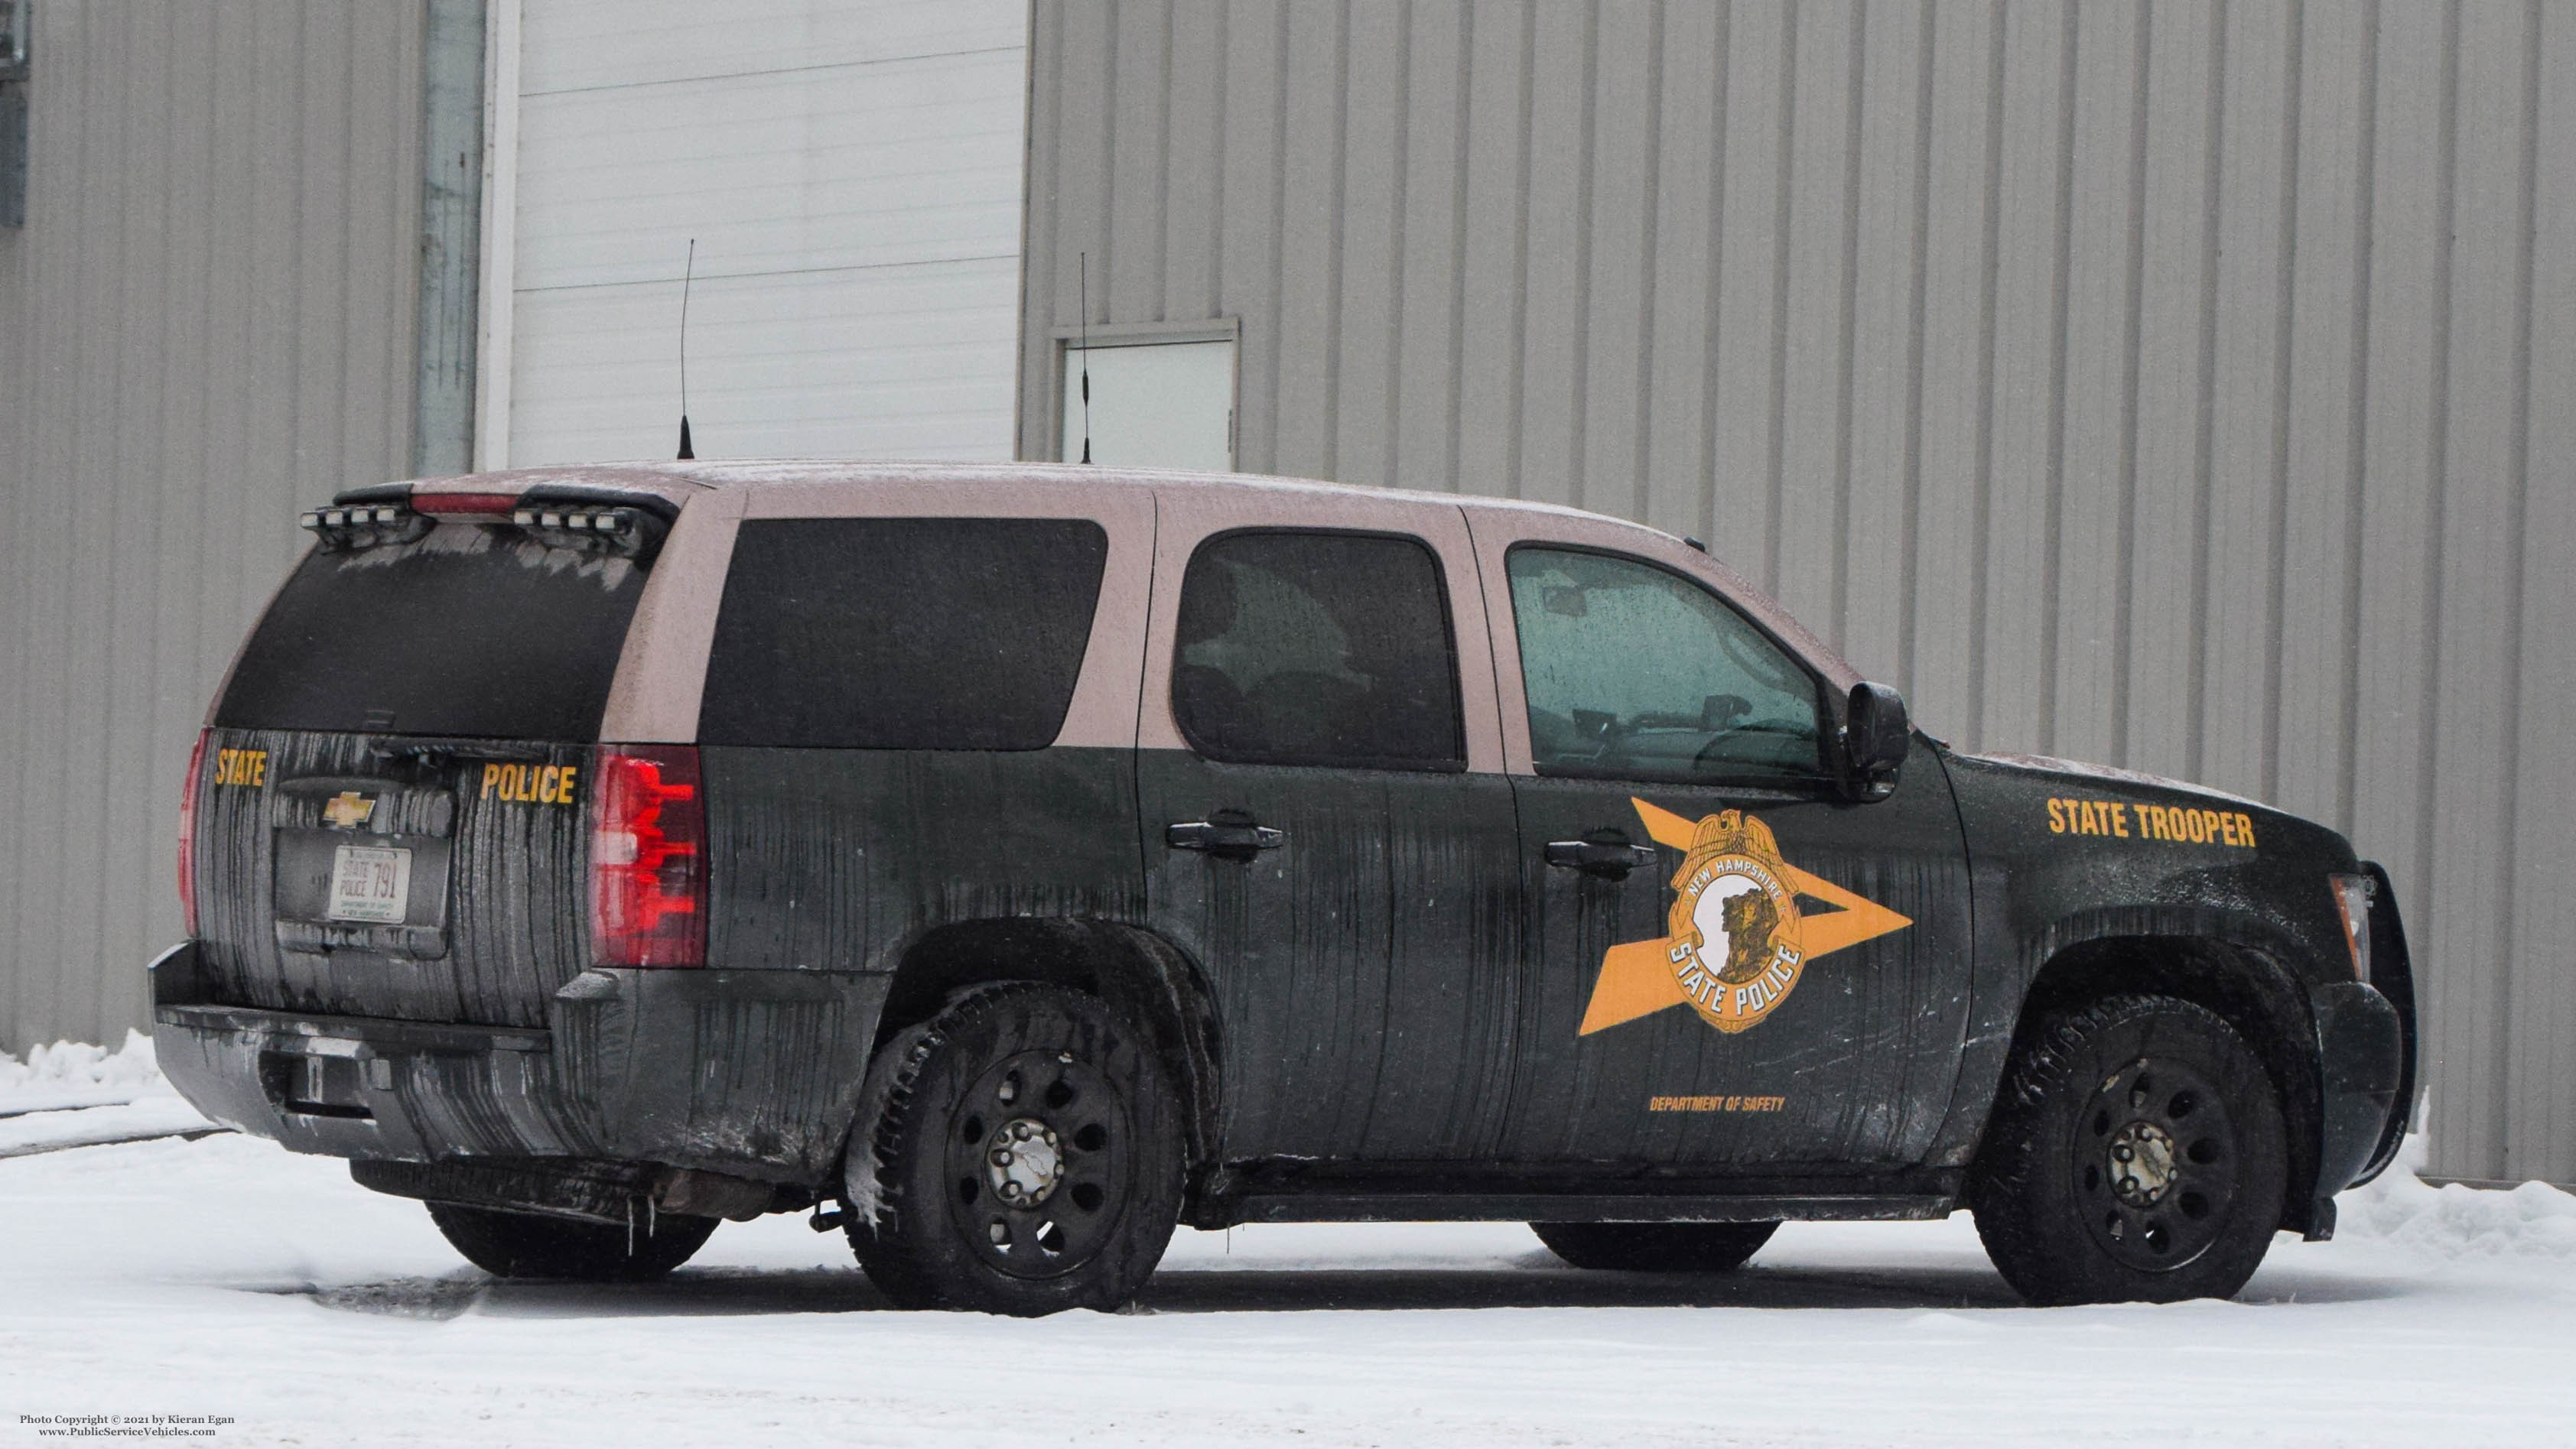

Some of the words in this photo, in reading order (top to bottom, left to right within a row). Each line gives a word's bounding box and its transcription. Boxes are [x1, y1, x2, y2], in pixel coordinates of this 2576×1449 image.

[216, 749, 266, 786] STATE
[481, 764, 576, 803] POLICE
[2047, 798, 2129, 838] STATE
[2132, 804, 2256, 847] TROOPER
[340, 880, 366, 897] POLICE
[343, 861, 369, 878] STATE
[373, 862, 398, 898] 791
[1687, 868, 1712, 896] NEW
[1716, 859, 1783, 901] HAMPSHIRE
[1670, 942, 1727, 1012] STATE
[1735, 944, 1801, 1016] POLICE
[1649, 1096, 1725, 1112] DEPARTMENT
[1725, 1096, 1741, 1112] OF
[1742, 1096, 1785, 1112] SAFETY
